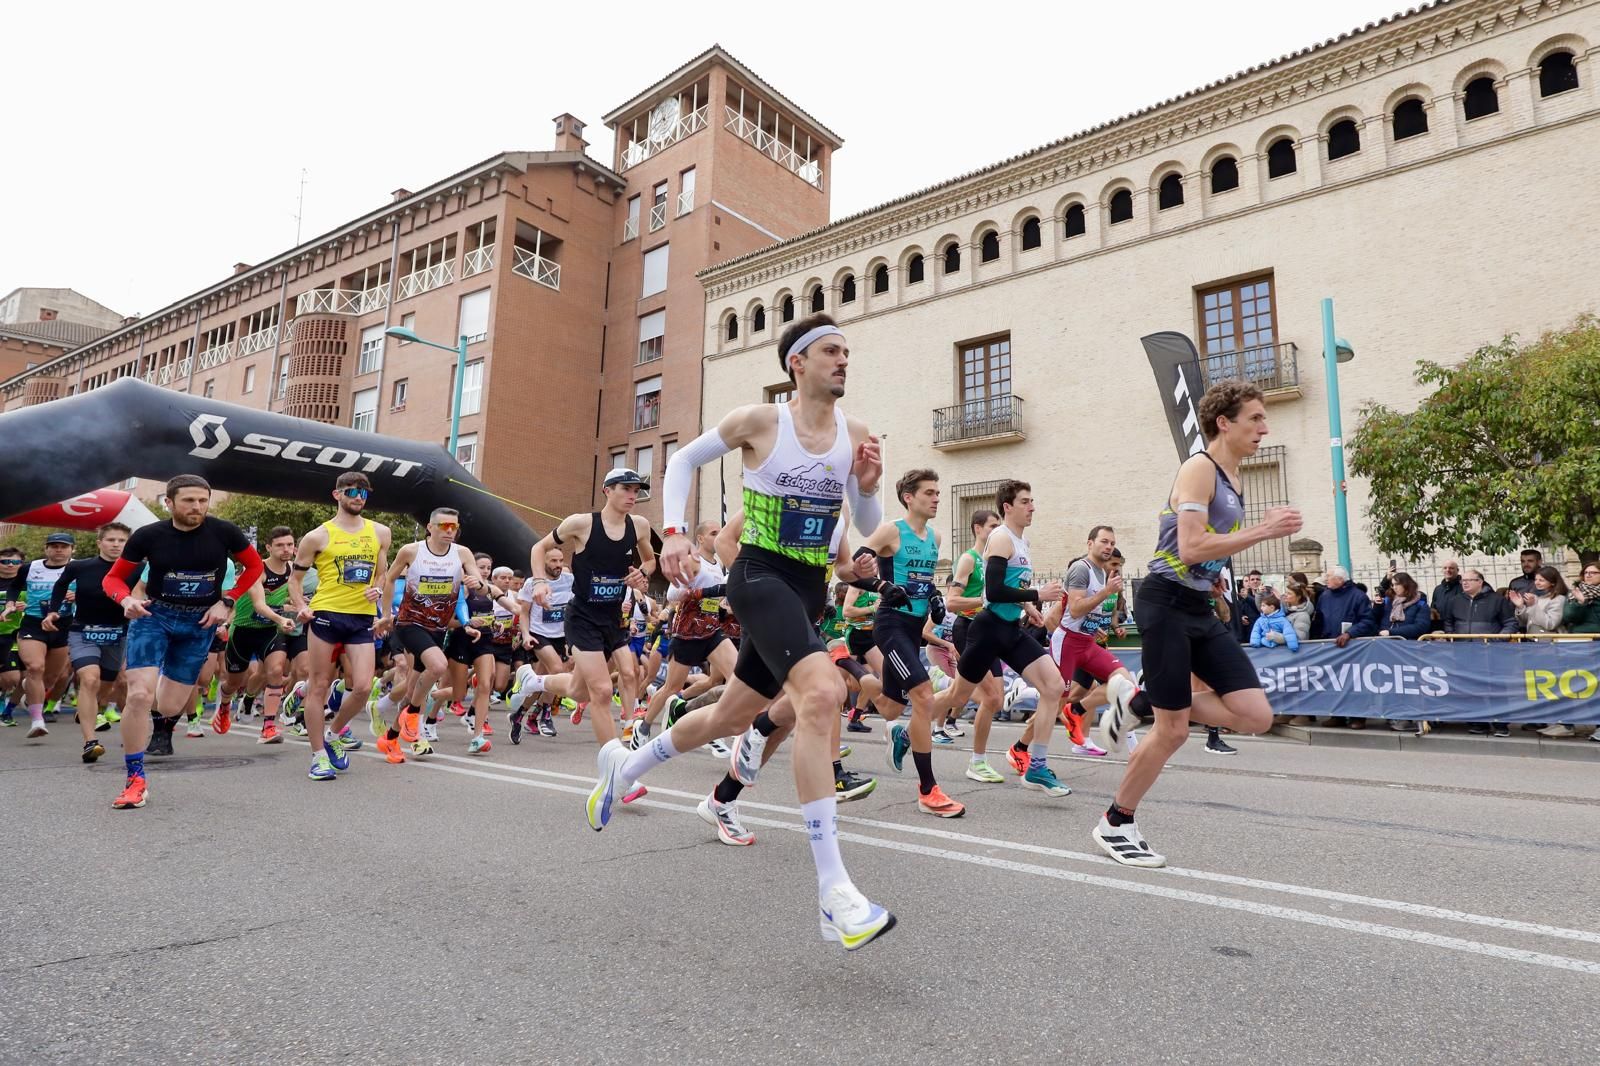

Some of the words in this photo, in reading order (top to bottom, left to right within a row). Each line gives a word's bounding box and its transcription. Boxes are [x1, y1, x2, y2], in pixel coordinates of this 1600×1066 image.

[234, 433, 423, 477] SCOTT
[776, 472, 817, 492] Esclops
[803, 517, 824, 535] 91
[355, 569, 368, 577] 88
[179, 582, 200, 591] 27
[917, 583, 929, 593] 24
[85, 632, 118, 641] 10018
[1256, 663, 1449, 697] SERVICES
[1525, 669, 1598, 701] RO
